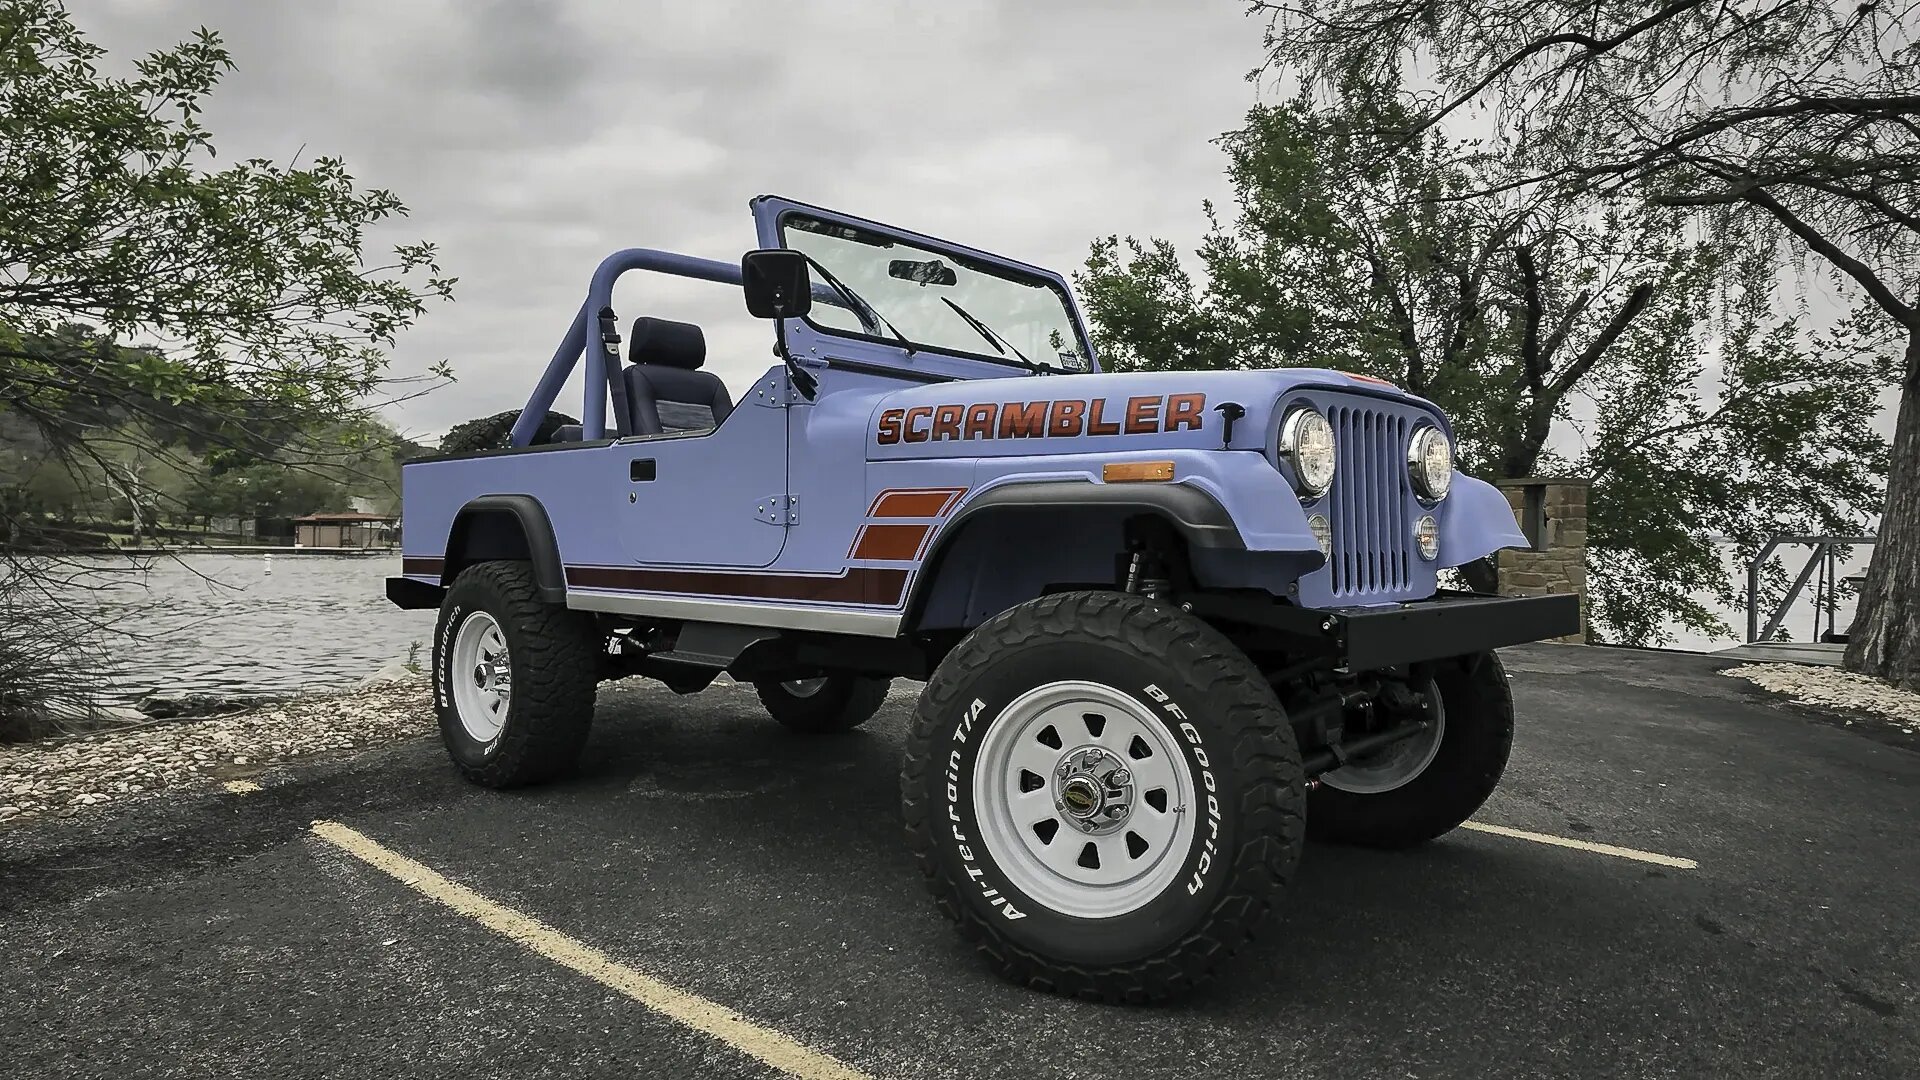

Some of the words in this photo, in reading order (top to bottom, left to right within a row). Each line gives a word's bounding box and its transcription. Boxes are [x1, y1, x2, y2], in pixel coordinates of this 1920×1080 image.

[877, 393, 1207, 444] SCRAMBLER
[439, 605, 461, 708] BFGoodrich
[953, 698, 987, 744] T/A
[945, 750, 1027, 920] All-Terrain
[1143, 684, 1221, 895] BFGoodrich
